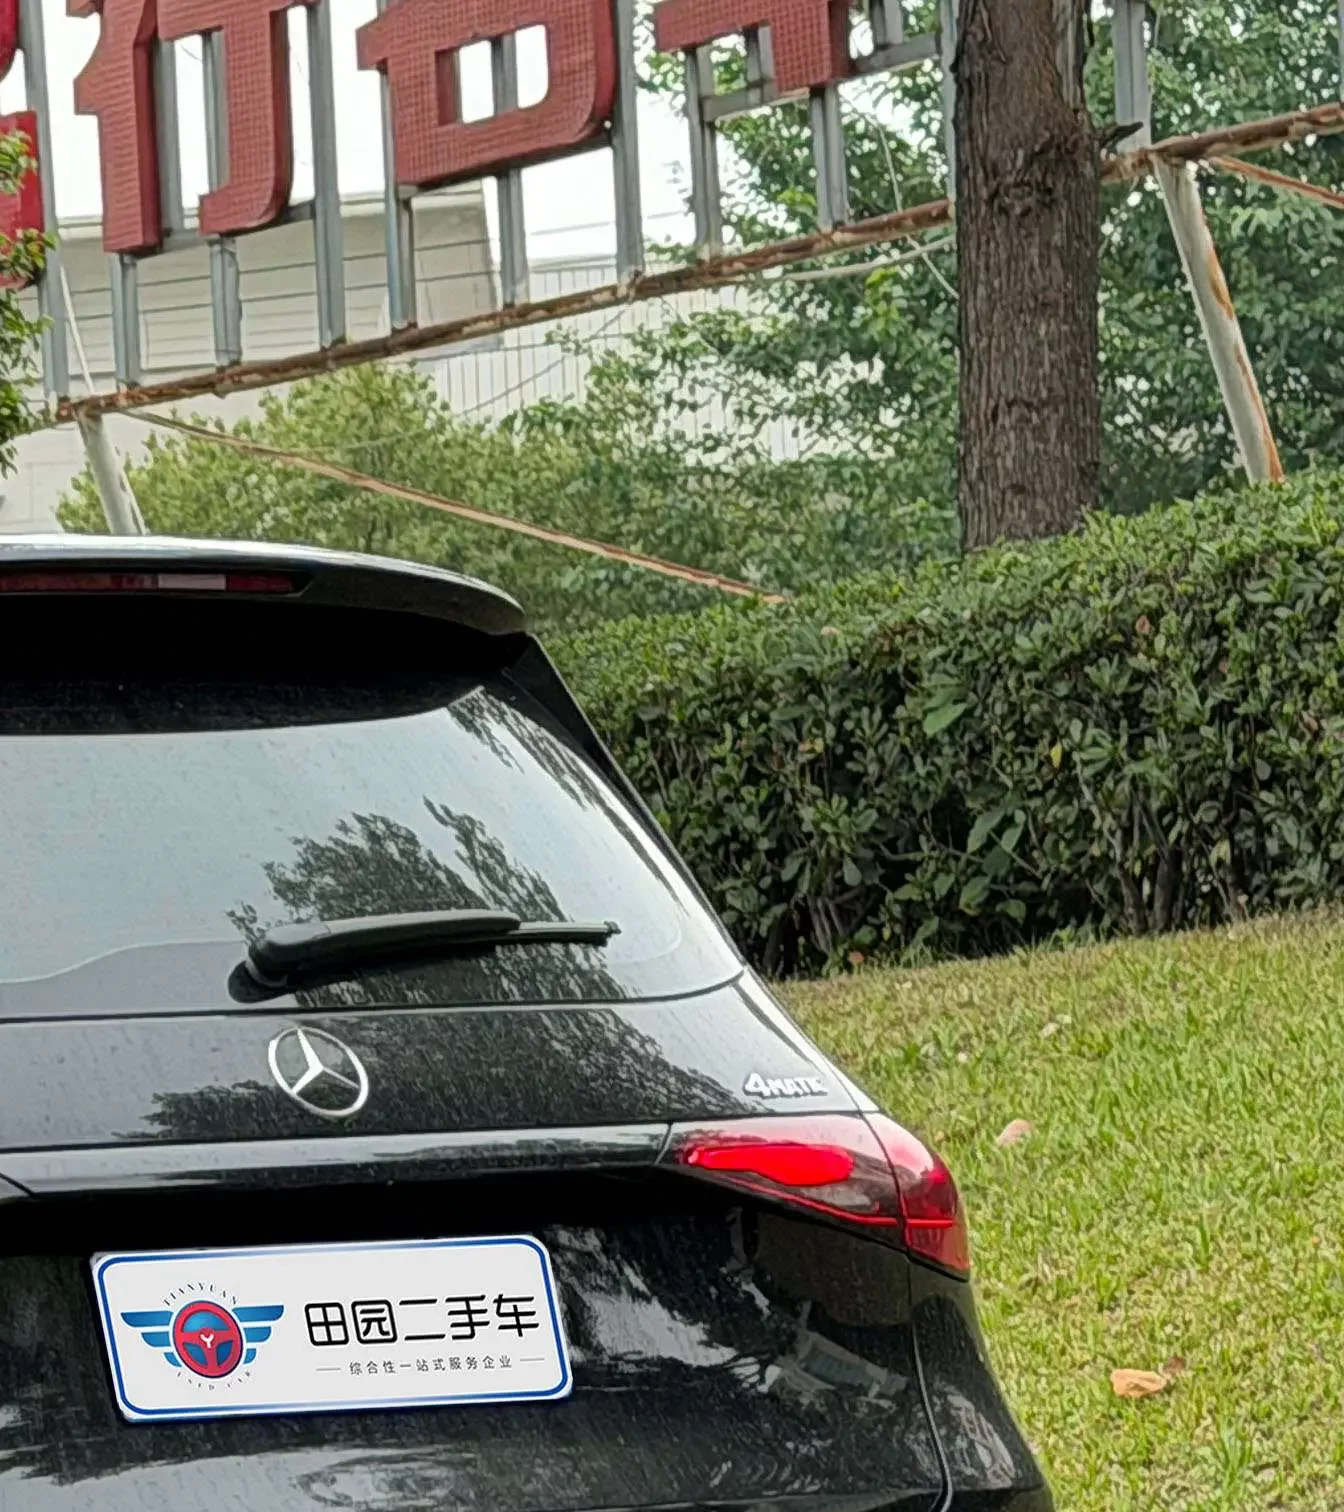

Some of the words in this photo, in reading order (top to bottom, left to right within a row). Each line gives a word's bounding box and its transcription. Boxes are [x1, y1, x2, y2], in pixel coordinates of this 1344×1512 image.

[304, 1294, 540, 1346] 田园二手车
[348, 1354, 513, 1376] 综合性一站式服务企业
